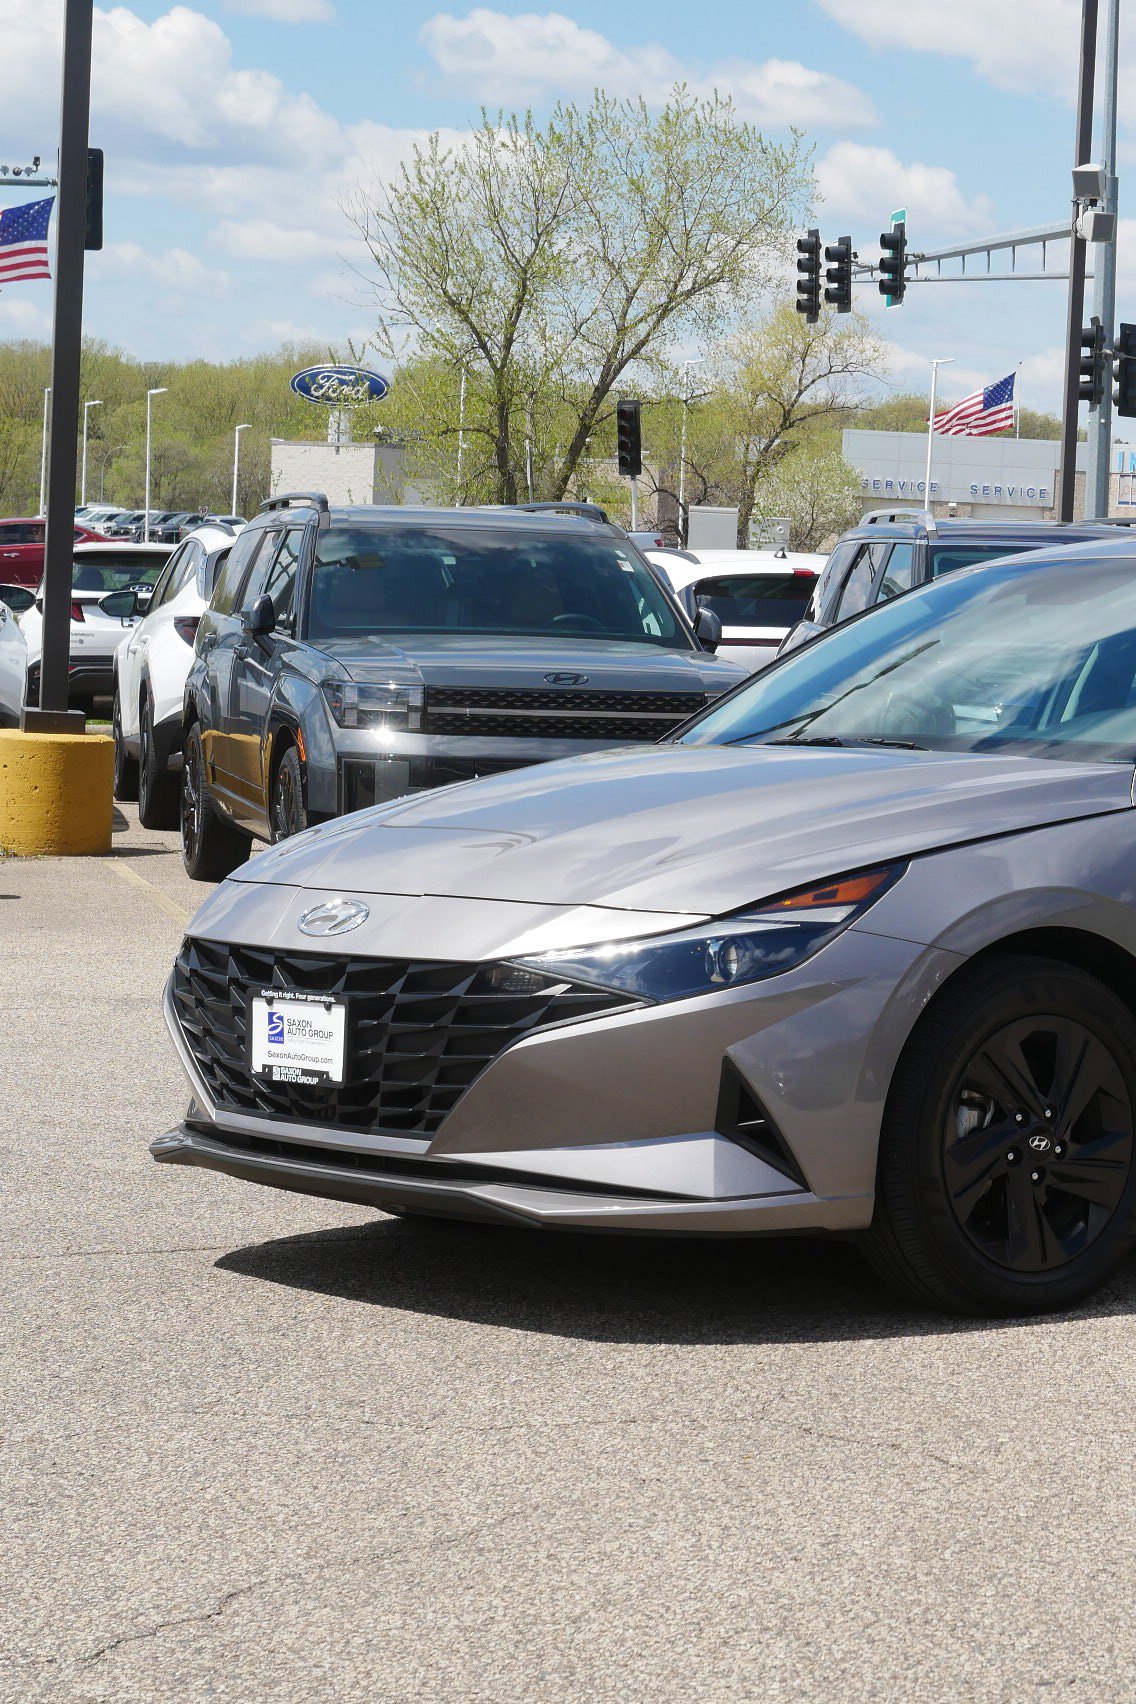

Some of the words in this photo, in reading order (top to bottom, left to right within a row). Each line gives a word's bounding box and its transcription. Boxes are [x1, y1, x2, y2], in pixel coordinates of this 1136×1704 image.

[311, 372, 370, 397] Ford
[861, 478, 939, 492] SERVICE
[969, 484, 1047, 499] SERVICE
[261, 989, 278, 999] Getting
[295, 992, 306, 1000] Four
[287, 1018, 312, 1028] SAXON
[287, 1026, 307, 1037] AUTO
[308, 1028, 334, 1039] GROUP
[267, 1050, 333, 1065] SaxonAutoGroup.com
[280, 1066, 302, 1076] SAXON
[280, 1074, 297, 1082] AUTO
[297, 1075, 319, 1085] GROUP
